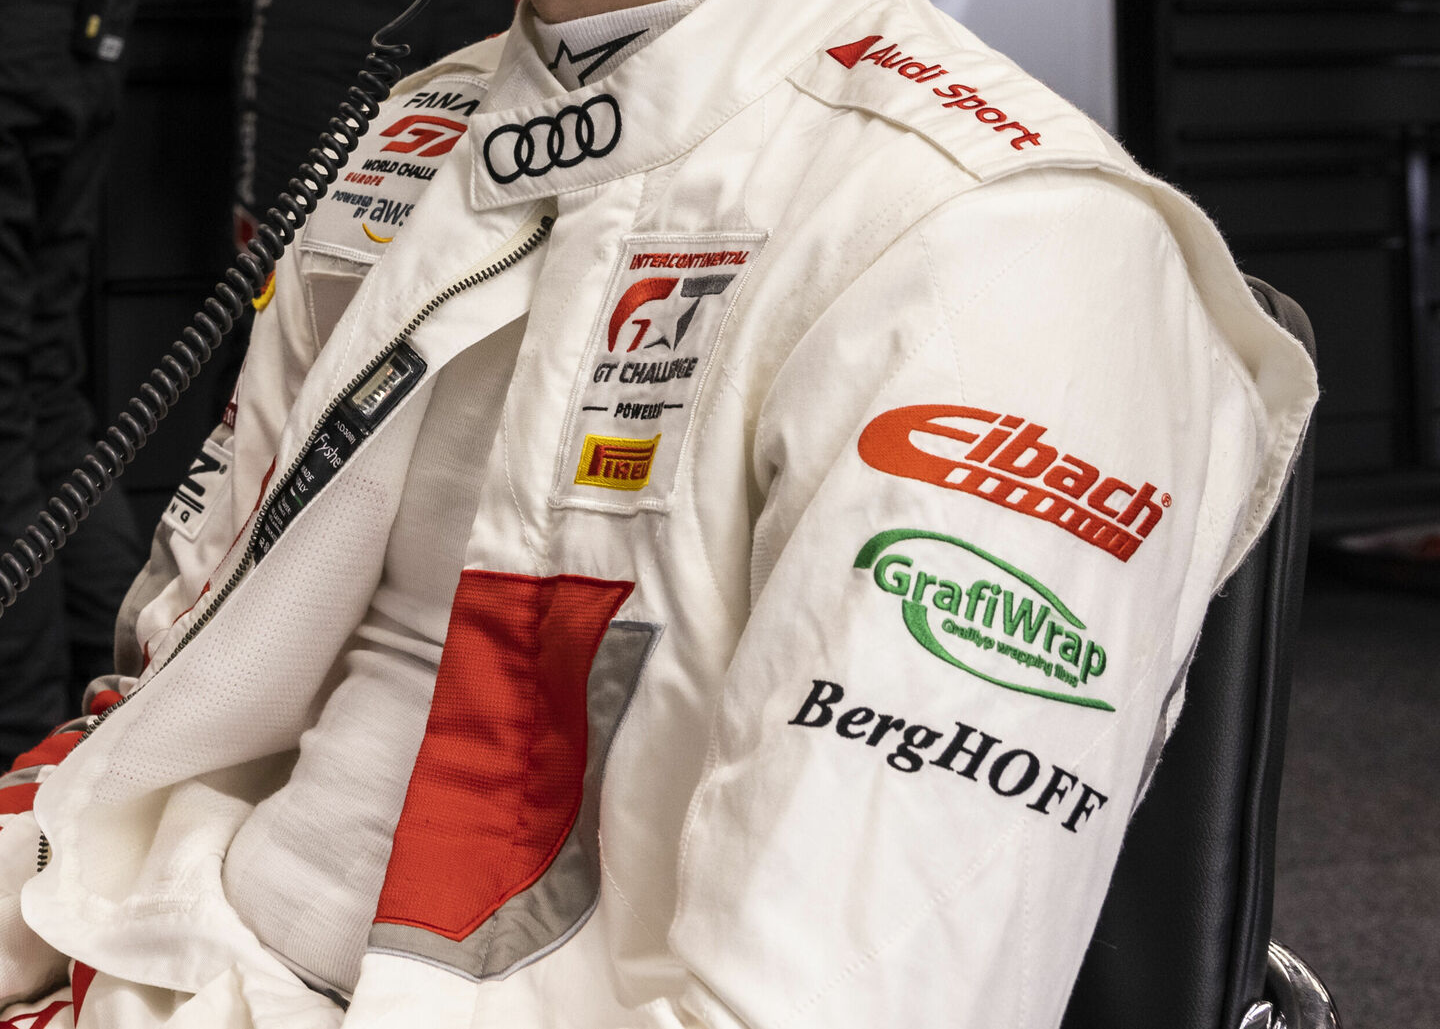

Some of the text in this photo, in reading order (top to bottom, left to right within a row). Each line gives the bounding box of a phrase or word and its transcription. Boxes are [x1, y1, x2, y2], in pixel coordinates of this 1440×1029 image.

[403, 91, 481, 118] FANA
[860, 43, 1042, 152] Audi Sport
[343, 172, 385, 187] EUROPE
[361, 158, 399, 174] WORLD
[593, 362, 619, 384] GT
[857, 404, 1164, 540] Eibach
[873, 554, 1108, 685] GrafiWrap
[787, 679, 1109, 834] BergHOFF
